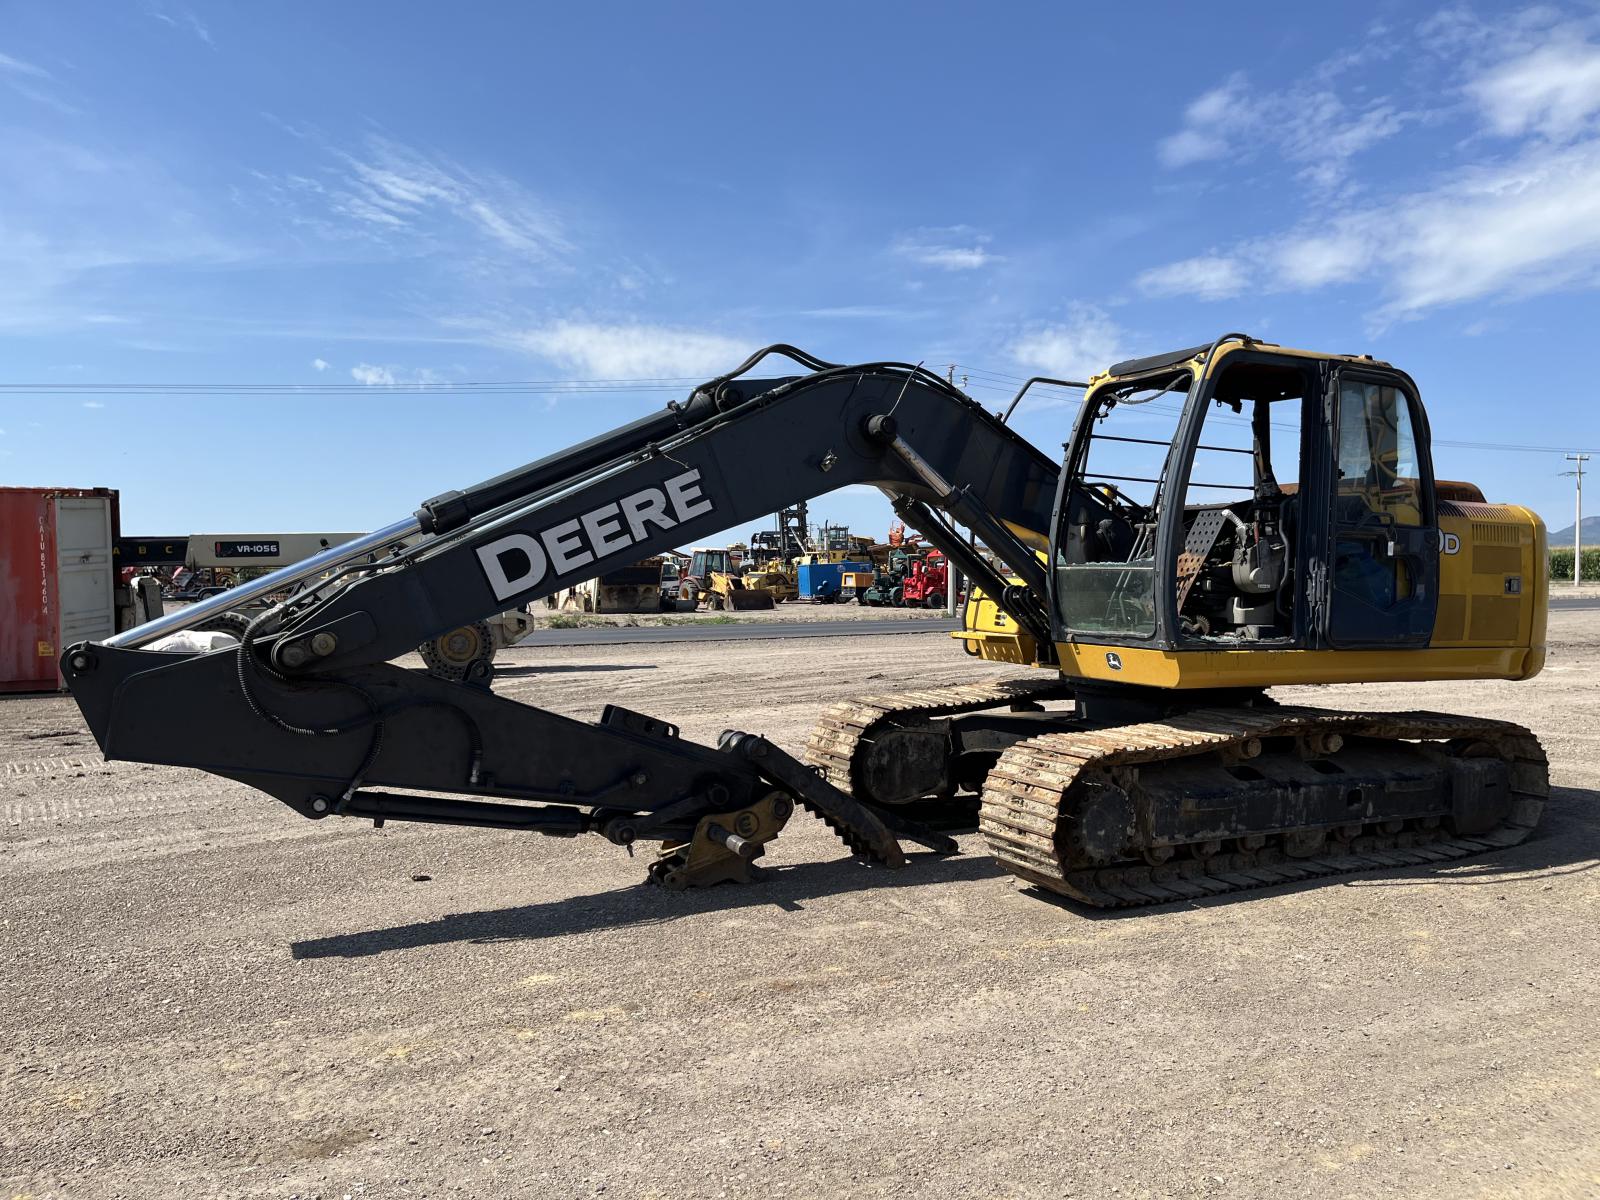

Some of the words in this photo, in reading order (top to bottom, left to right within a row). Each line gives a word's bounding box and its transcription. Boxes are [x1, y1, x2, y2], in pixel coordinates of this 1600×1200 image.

[476, 468, 713, 601] DEERE
[165, 545, 173, 554] C
[237, 545, 278, 553] VR-1056
